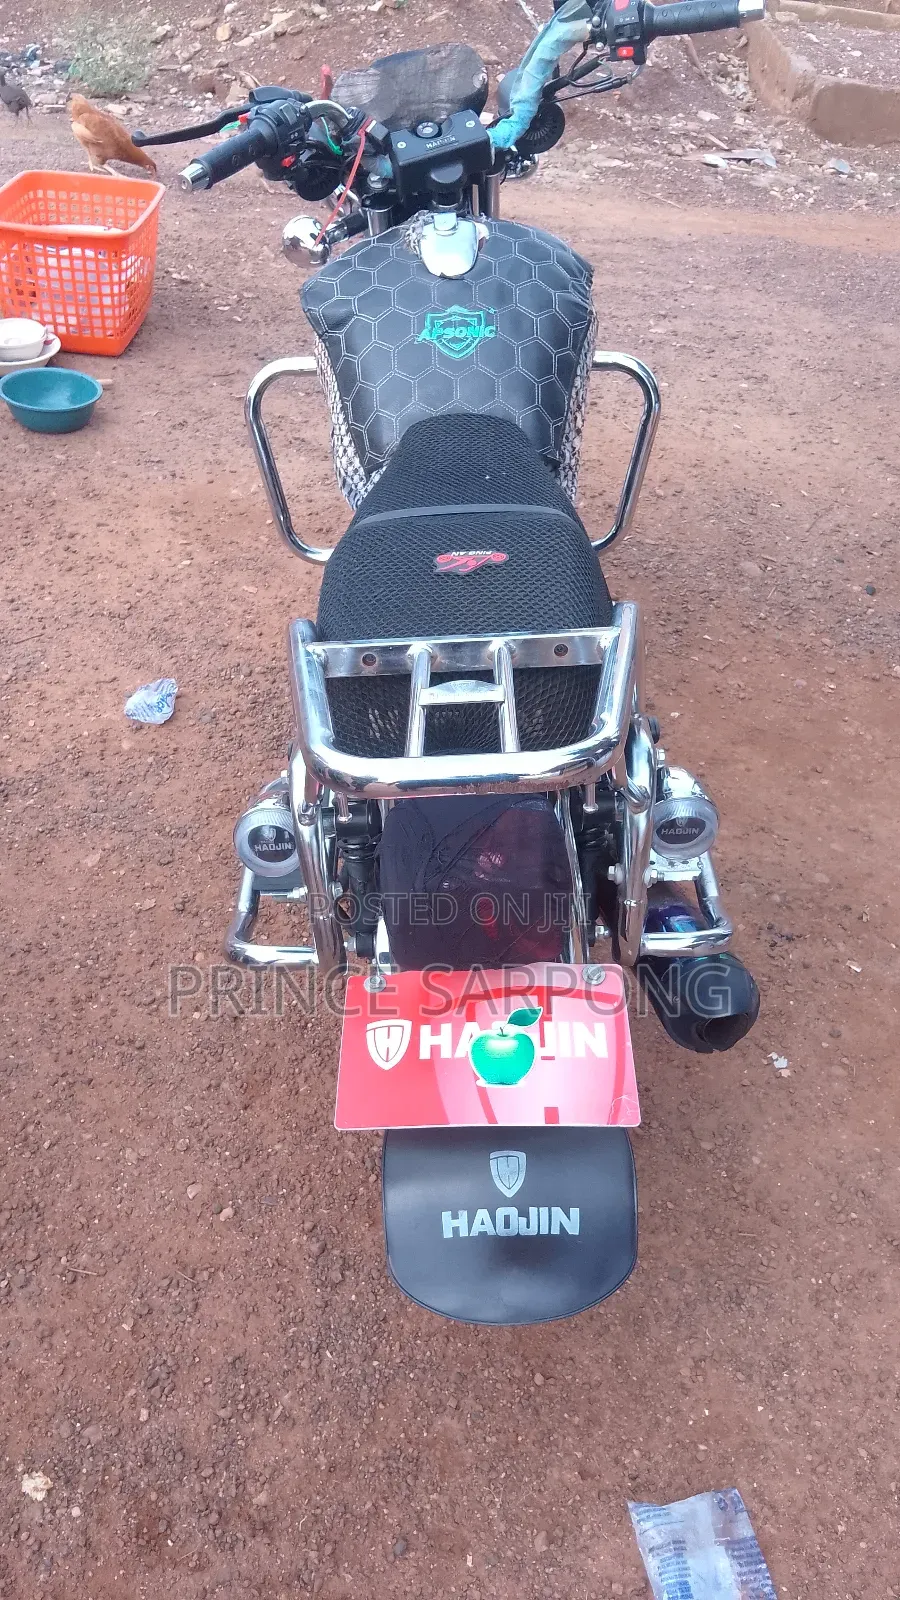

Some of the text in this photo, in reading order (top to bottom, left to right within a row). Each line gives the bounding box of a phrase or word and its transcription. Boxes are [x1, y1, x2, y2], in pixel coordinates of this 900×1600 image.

[415, 325, 496, 343] APSONIC
[660, 827, 700, 836] HAOJIN
[254, 842, 293, 853] HAOJIN
[418, 1021, 609, 1060] HAJIN
[441, 1206, 580, 1239] HAOJIN
